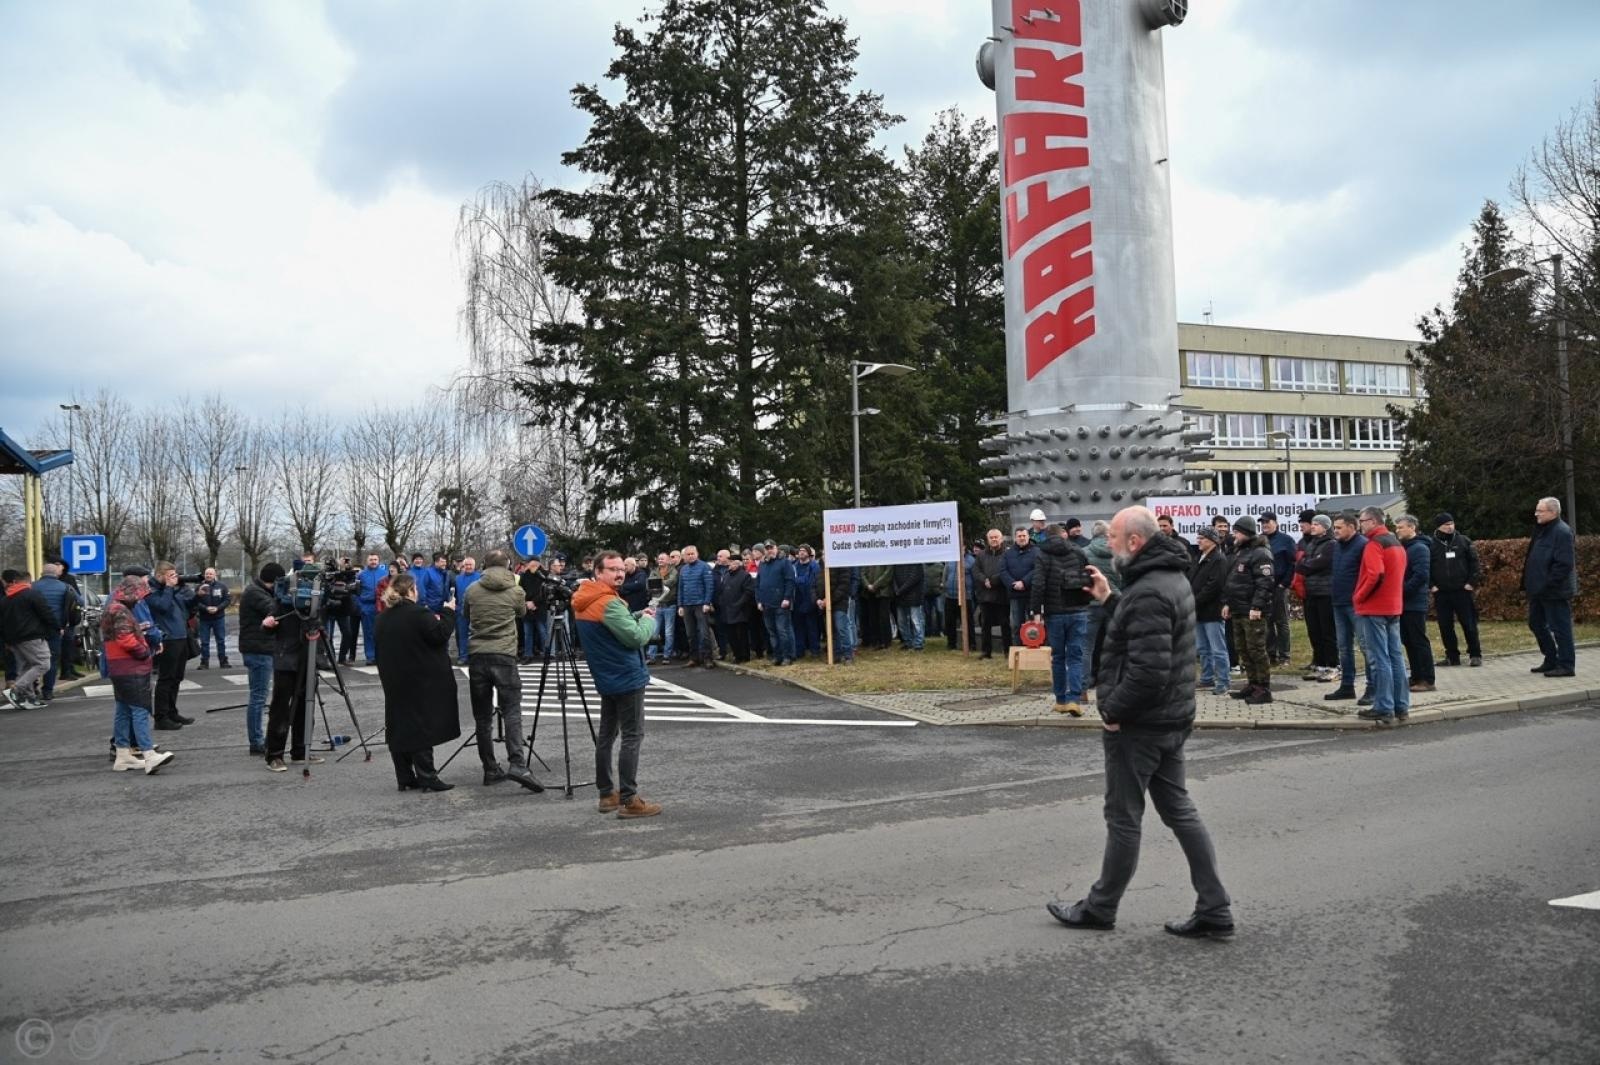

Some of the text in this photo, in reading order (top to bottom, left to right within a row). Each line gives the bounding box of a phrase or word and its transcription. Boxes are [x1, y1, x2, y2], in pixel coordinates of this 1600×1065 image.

[1004, 0, 1095, 381] RAFAKO
[1155, 504, 1201, 517] RAFAKO
[1206, 504, 1218, 516] to
[1223, 504, 1242, 516] nie
[829, 517, 952, 534] RAFAKO zastąpią zachodnie firmy(?!)
[832, 534, 952, 551] Cudze chwalicie, swego nie znacie!
[72, 540, 97, 569] P
